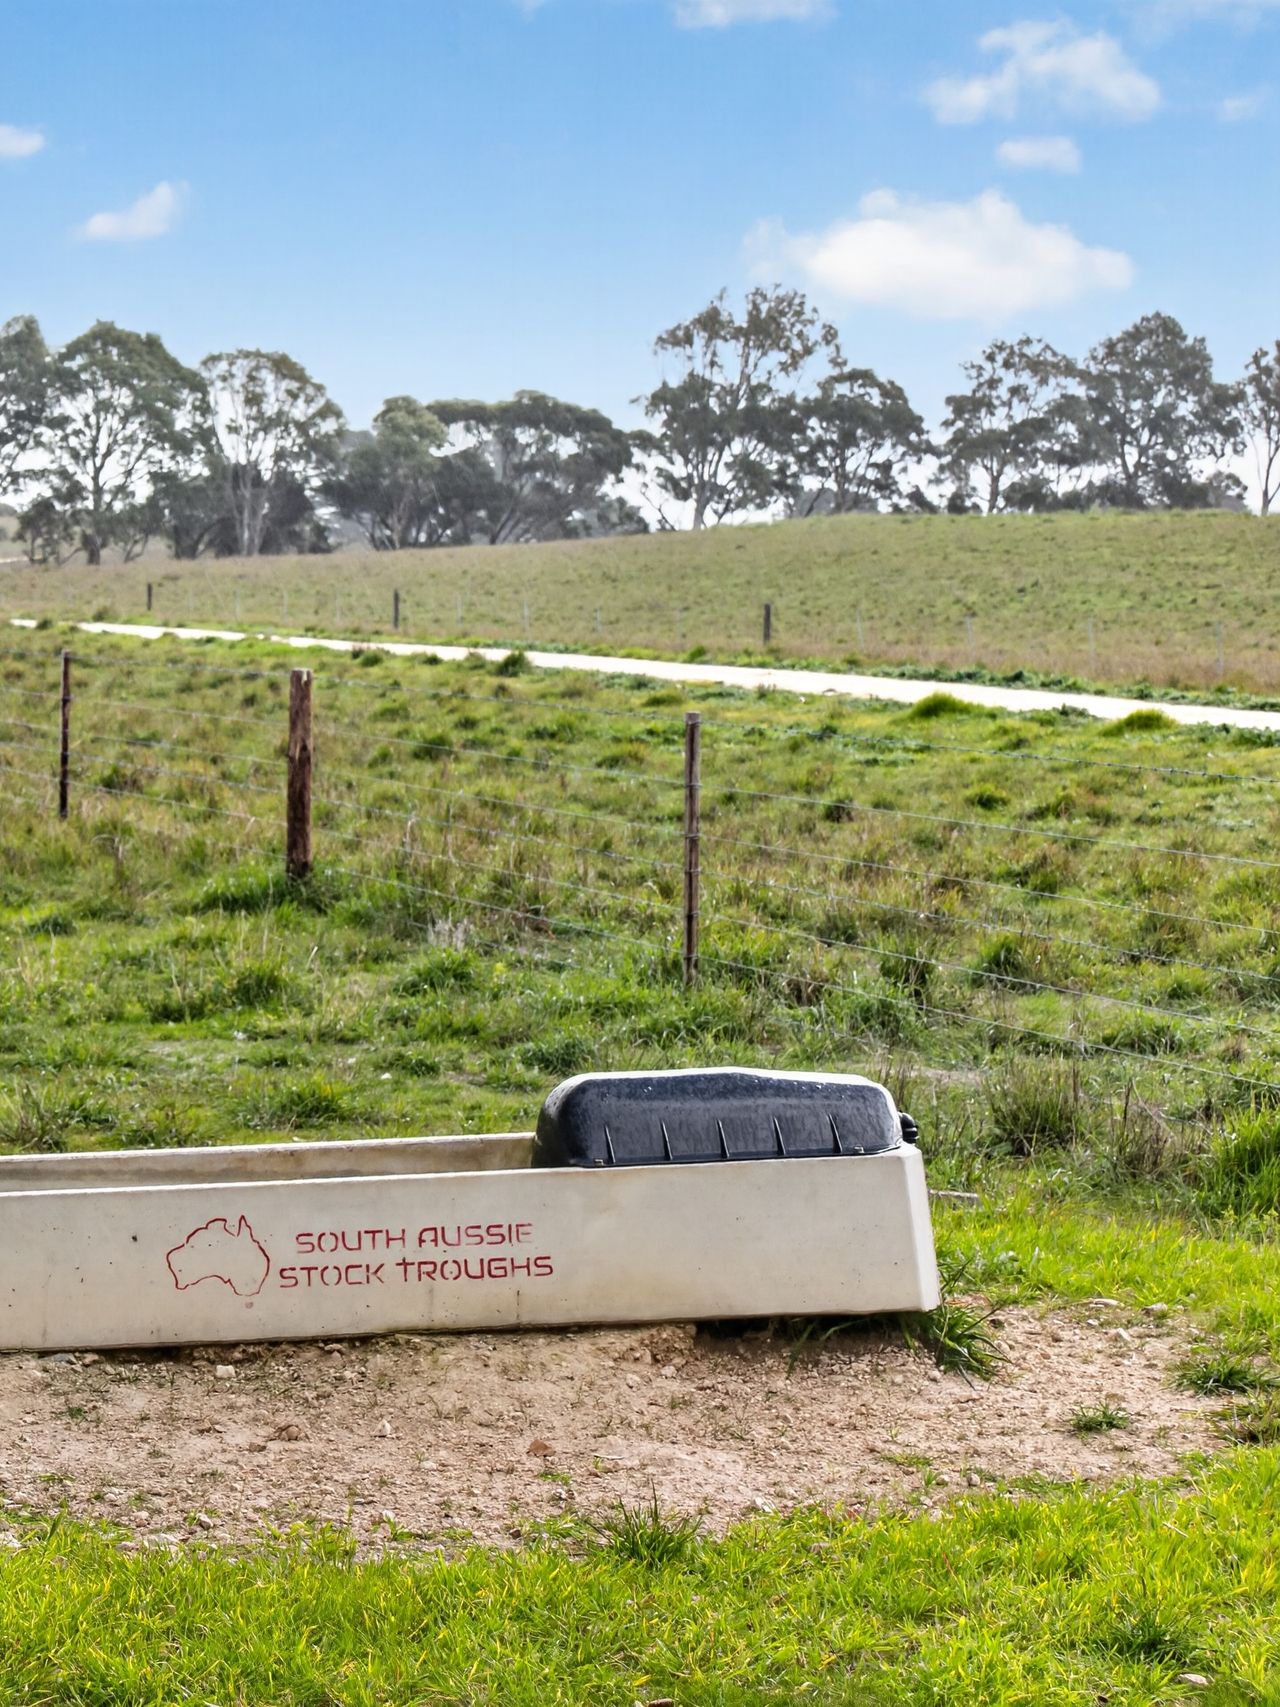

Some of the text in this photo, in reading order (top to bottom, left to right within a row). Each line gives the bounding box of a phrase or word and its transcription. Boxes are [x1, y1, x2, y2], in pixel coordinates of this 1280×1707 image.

[295, 1223, 533, 1254] SOUTH AUSSIE
[279, 1256, 554, 1288] STOCK TROUGHS
